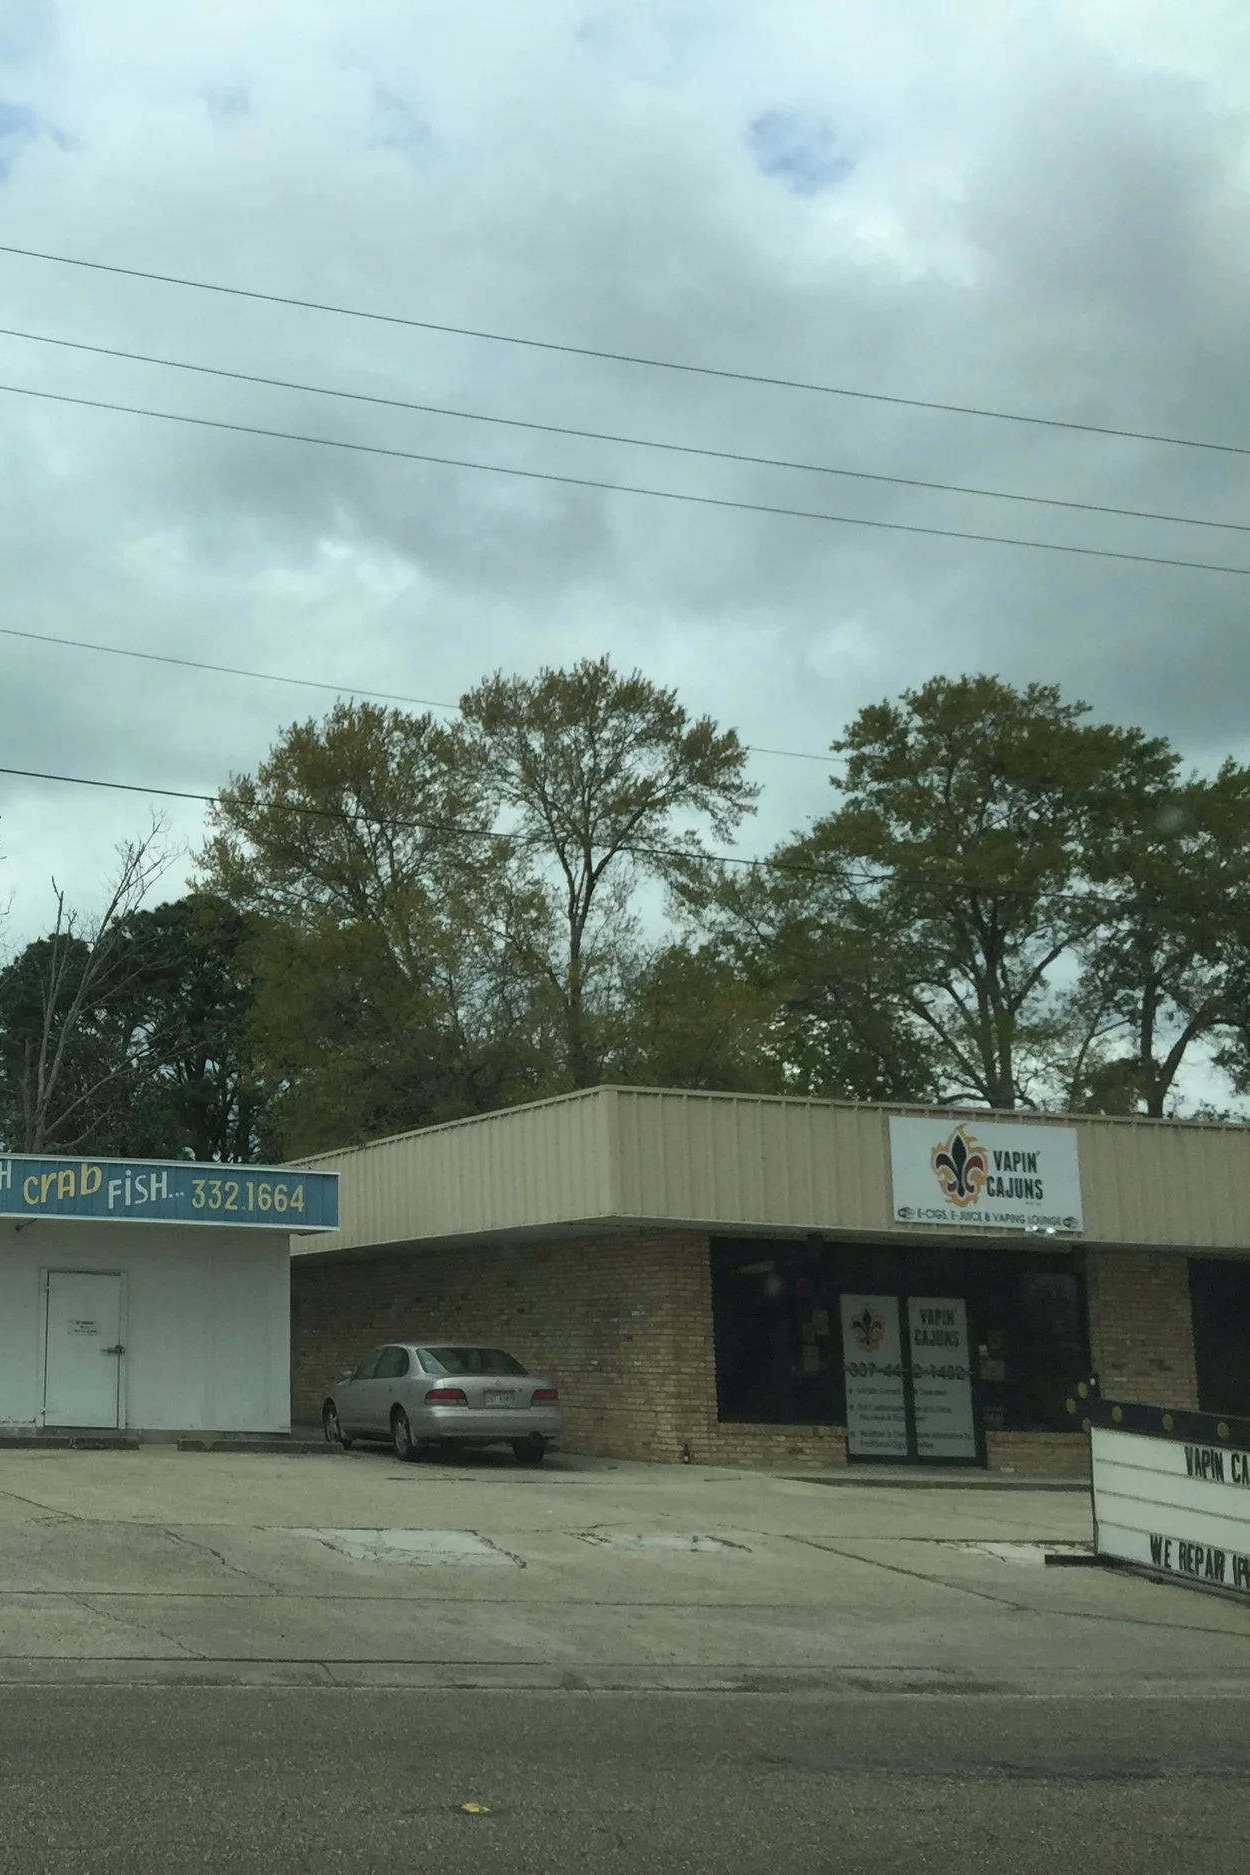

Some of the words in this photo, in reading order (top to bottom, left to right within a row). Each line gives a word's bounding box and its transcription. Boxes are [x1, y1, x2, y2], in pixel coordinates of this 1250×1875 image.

[986, 1175, 1044, 1201] CAJUNS
[994, 1212, 1026, 1225] VAPING
[914, 1329, 960, 1348] CAJUNS
[1184, 1446, 1225, 1482] VAPIN
[1150, 1534, 1172, 1569] WE
